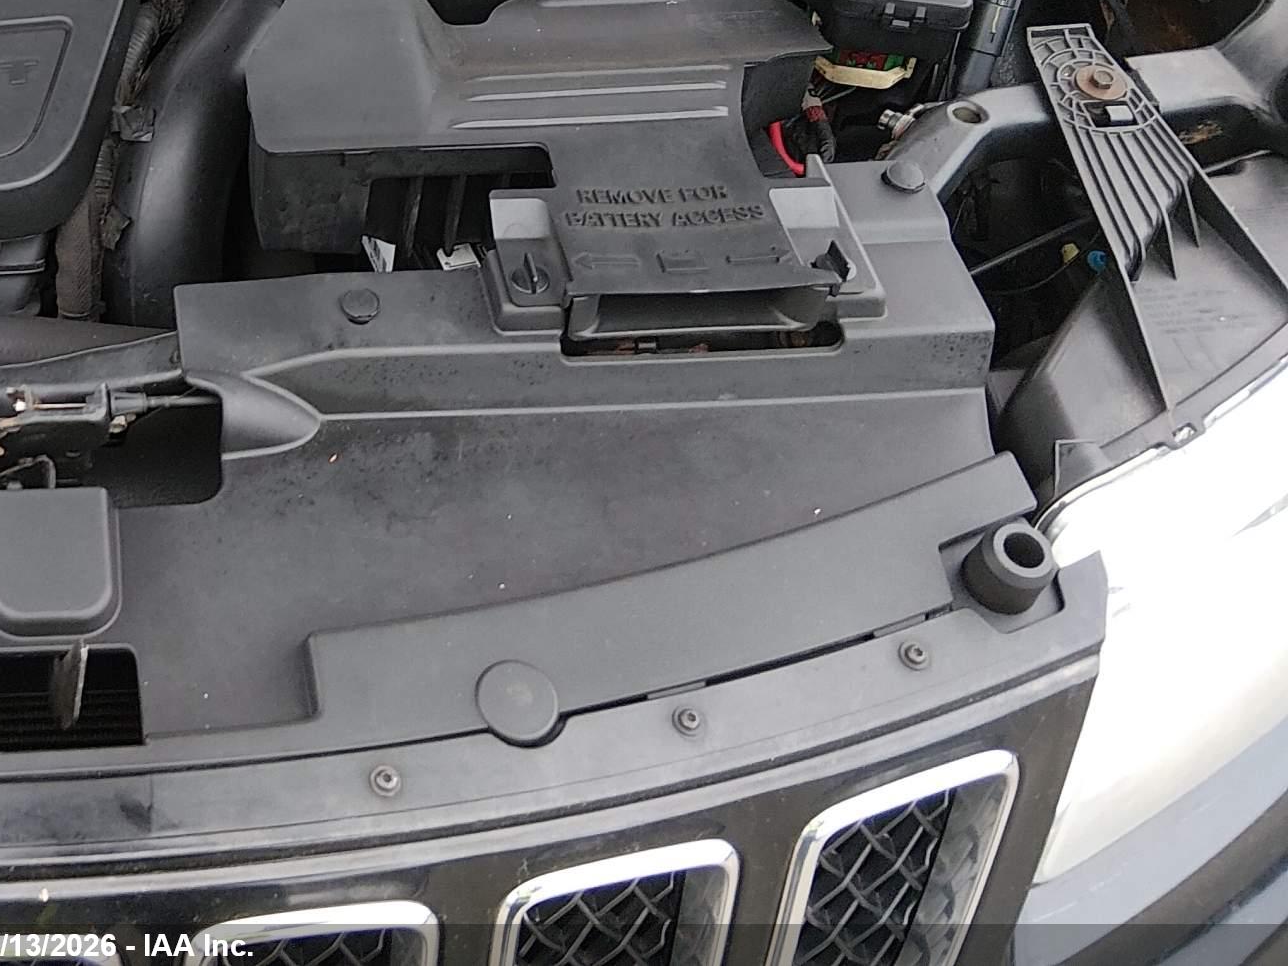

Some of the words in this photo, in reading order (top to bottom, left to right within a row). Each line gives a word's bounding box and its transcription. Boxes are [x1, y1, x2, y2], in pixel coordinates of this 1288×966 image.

[575, 187, 673, 205] REMOVE
[677, 185, 728, 203] FOR
[564, 210, 663, 228] BATTERY
[671, 205, 765, 228] ACCESS
